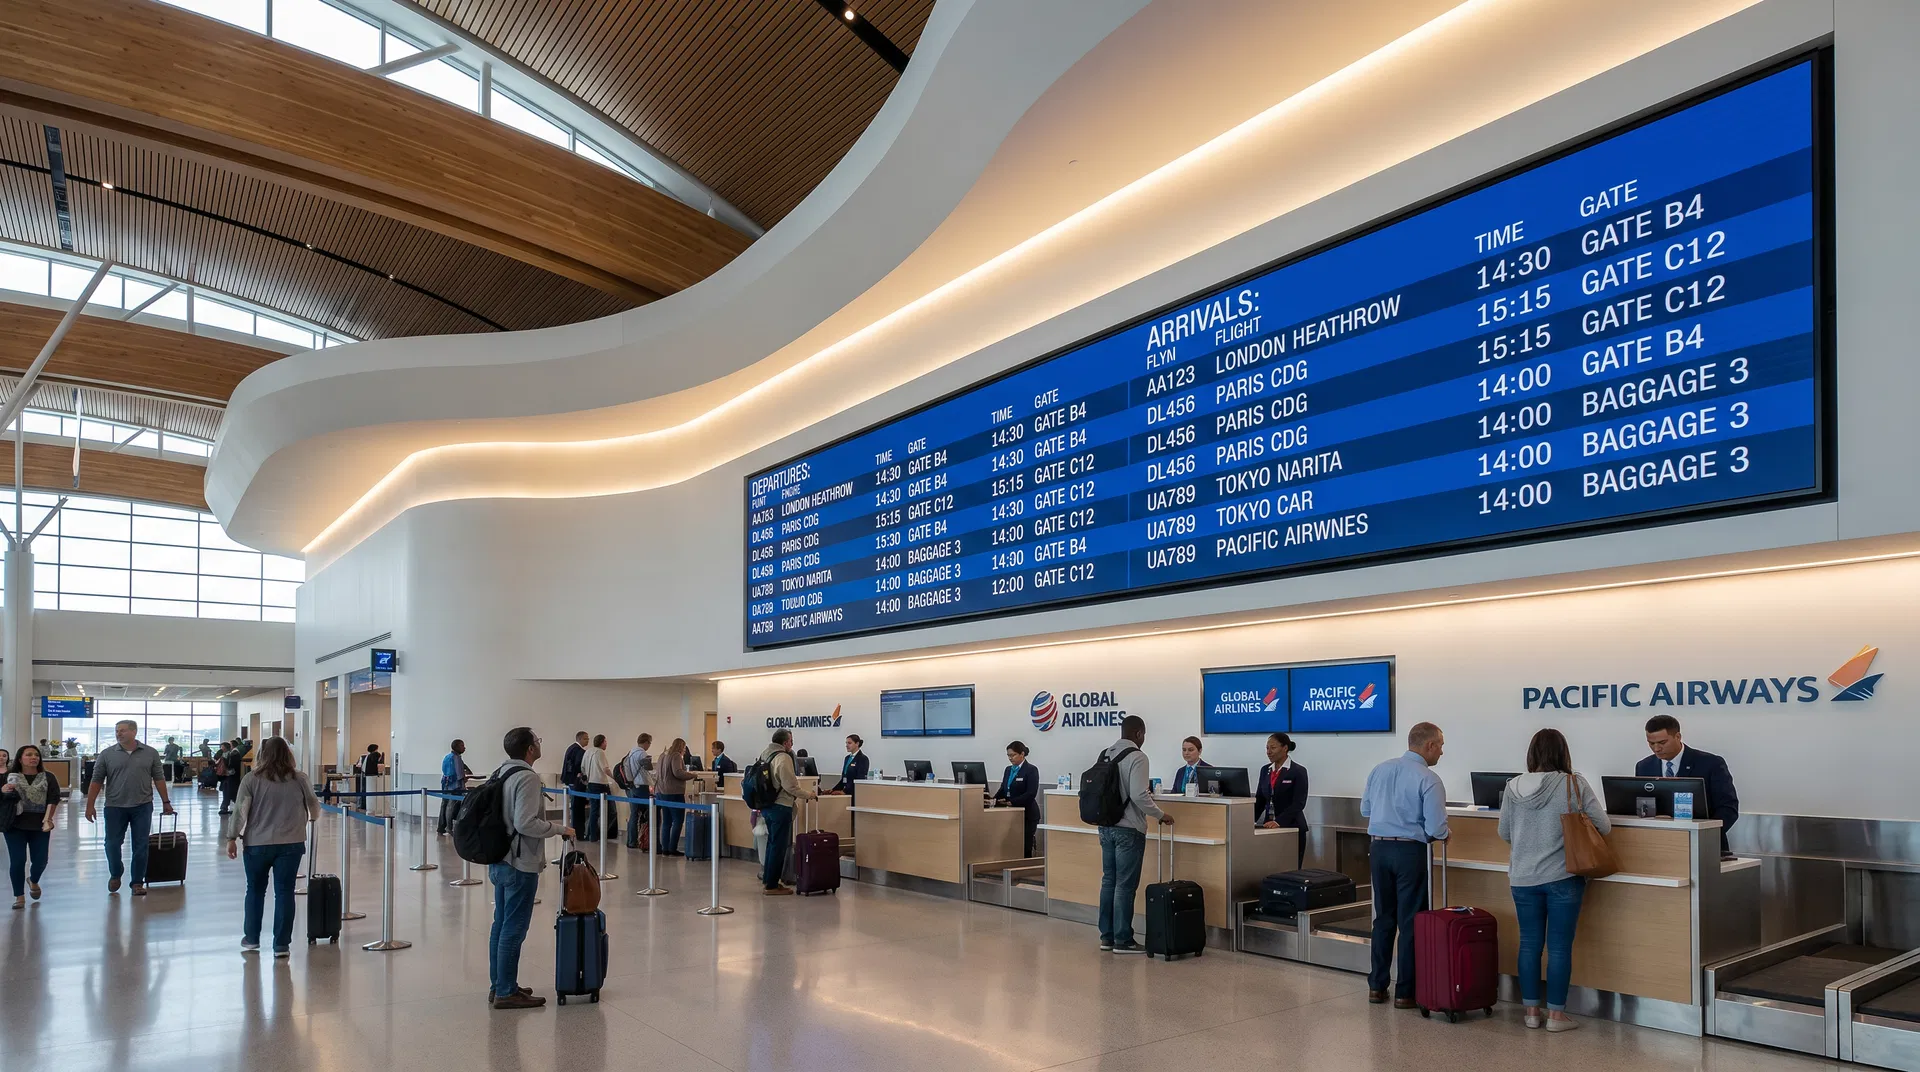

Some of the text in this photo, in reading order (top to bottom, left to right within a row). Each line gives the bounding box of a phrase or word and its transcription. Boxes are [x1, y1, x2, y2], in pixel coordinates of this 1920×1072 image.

[1475, 179, 1638, 253] TIME GATE
[1147, 194, 1704, 397] AA123 LONDON HEATHROW 14:30 GATE B4
[1147, 290, 1259, 351] ARRIVALS:
[1148, 231, 1725, 425] DL456 PARIS CDG 15:15 GATE C12
[1147, 315, 1261, 369] FLYN FLIGHT
[1148, 275, 1725, 454] DL456 PARIS CDG 15:15 GATE C12
[991, 388, 1058, 424] TIME GATE
[1148, 324, 1704, 482] DL456 PARIS CDG 14:00 GATE B4
[992, 402, 1086, 447] 14:30 GATE B4
[1148, 358, 1748, 511] UA789 TOKYO NARITA 14:00 BAGGAGE 3
[876, 437, 926, 465] TIME GATE
[992, 429, 1086, 472] 14:30 GATE B4
[1148, 402, 1749, 540] UA789 TOKYO CAR 14:00 BAGGAGE 3
[752, 463, 810, 497] DEPARTURES:
[782, 496, 810, 516] LONDON
[812, 482, 853, 507] HEATHROW
[876, 465, 901, 485] 14:30
[908, 455, 931, 475] GATE
[935, 450, 947, 467] B4
[992, 454, 1094, 496] 15:15 GATE C12
[782, 519, 801, 535] PARIS
[804, 513, 818, 528] CDG
[876, 488, 900, 506] 14:30
[908, 477, 931, 497] GATE
[935, 473, 947, 489] B4
[992, 481, 1094, 521] 14:30 GATE C12
[1148, 447, 1749, 569] UA789 PACIFIC AIRWNES 14:00 BAGGAGE 3
[782, 538, 801, 554] PARIS
[804, 533, 818, 548] CDG
[876, 509, 900, 528] 15:15
[908, 500, 931, 520] GATE
[934, 495, 953, 512] C12
[992, 508, 1094, 545] 14:00 GATE C12
[781, 575, 804, 592] TOKYO
[806, 569, 832, 586] NARITA
[876, 553, 900, 571] 14:00
[908, 541, 951, 564] BAGGAGE
[955, 540, 961, 554] 3
[782, 557, 801, 572] PARIS
[804, 552, 820, 567] CDG
[876, 532, 900, 549] 15:30
[908, 523, 931, 542] GATE
[935, 520, 947, 536] B4
[1035, 541, 1065, 562] GATE
[1070, 537, 1087, 555] B4
[876, 576, 900, 592] 14:00
[908, 565, 951, 587] BAGGAGE
[955, 563, 961, 578] 3
[992, 563, 1094, 595] 12:00 GATE C12
[809, 608, 843, 626] AIRWAYS
[876, 598, 900, 614] 14:00
[908, 588, 951, 609] BAGGAGE
[955, 587, 961, 601] 3
[1062, 692, 1118, 708] GLOBAL
[1214, 703, 1261, 714] AIRLINES
[1220, 691, 1261, 702] GLOBAL
[1302, 699, 1356, 711] AIRWAYS
[1310, 686, 1356, 699] PACIFIC
[1523, 676, 1819, 709] PACIFIC AIRWAYS
[767, 716, 793, 728] GLOBAL
